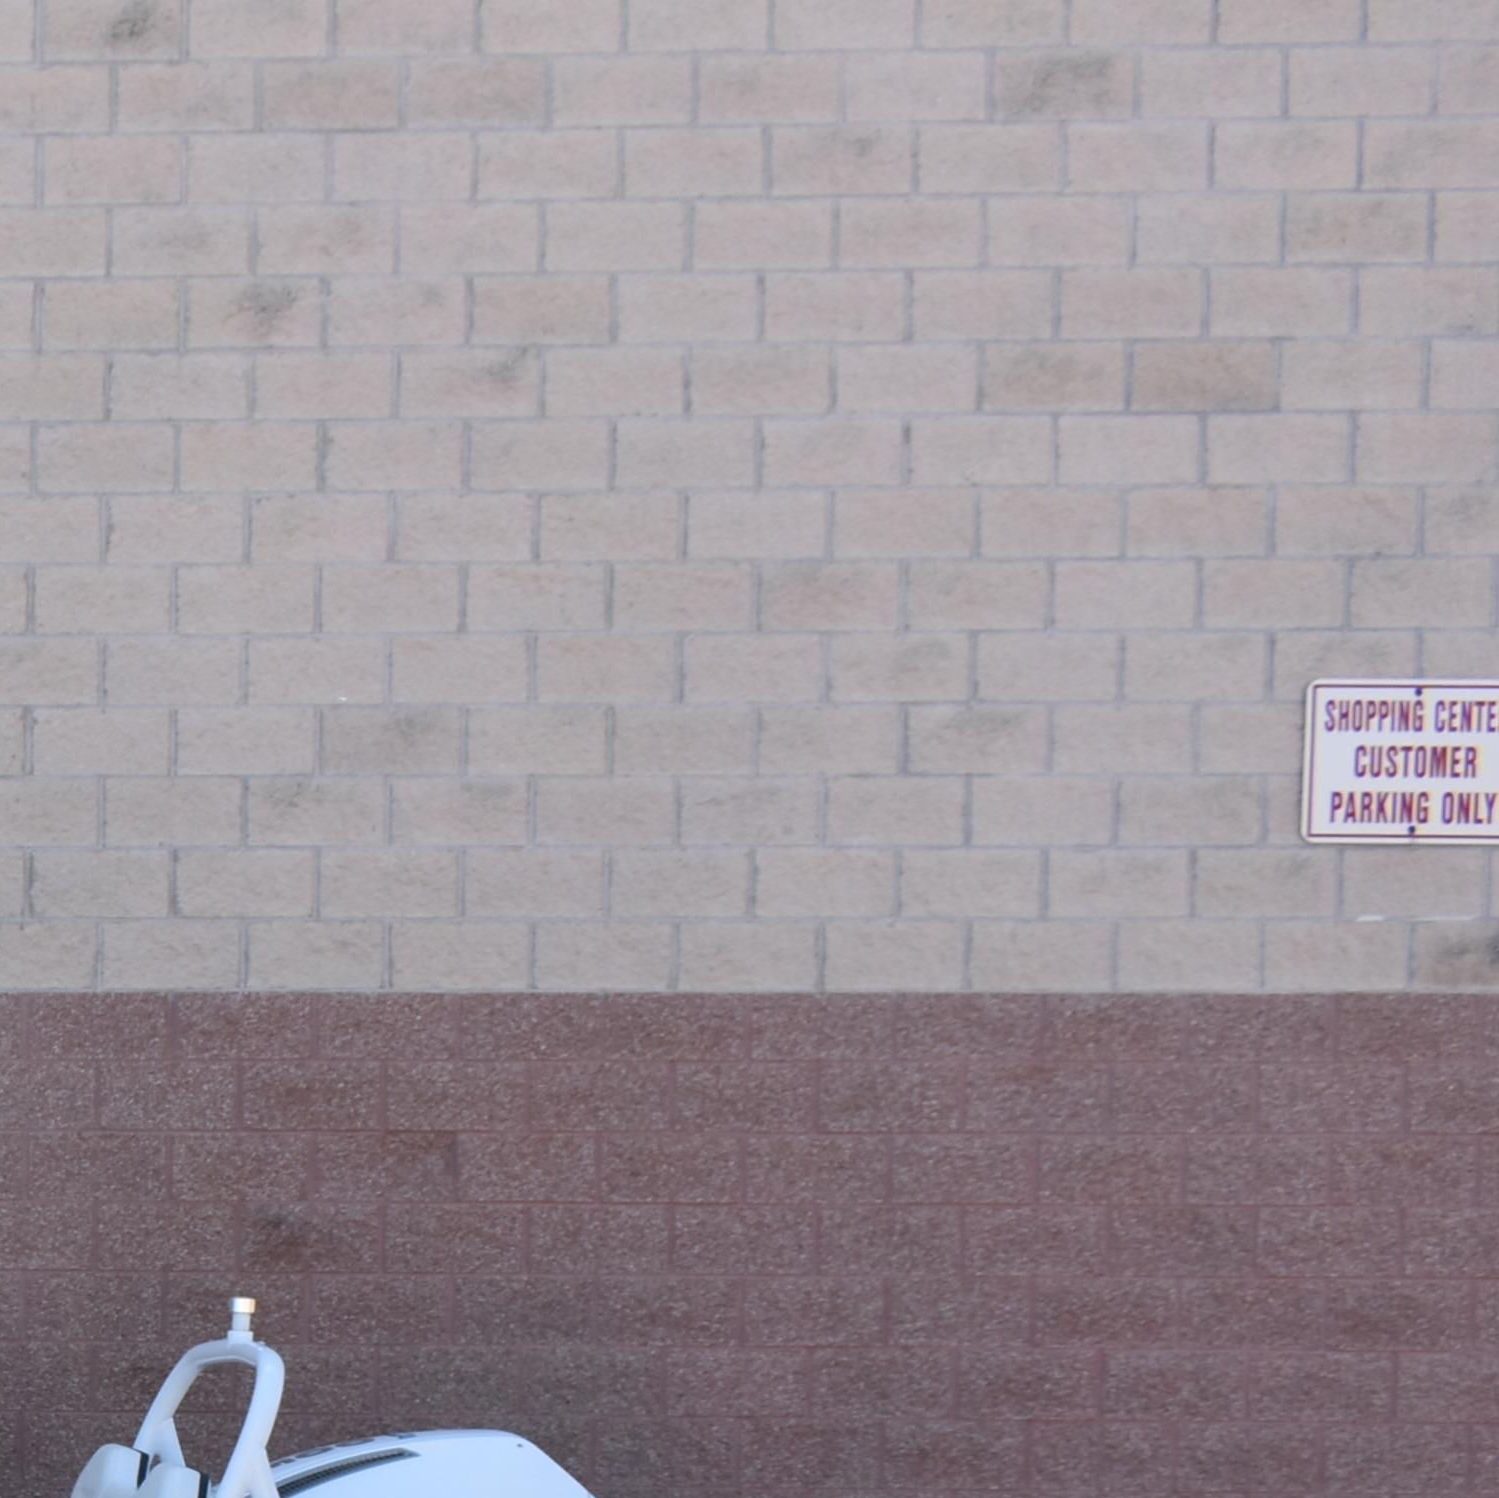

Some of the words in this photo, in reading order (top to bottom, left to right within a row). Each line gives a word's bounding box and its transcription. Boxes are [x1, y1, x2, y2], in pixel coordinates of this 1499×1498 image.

[1324, 699, 1425, 733] SHOPPING
[1434, 700, 1499, 733] CENTE
[1354, 745, 1478, 779] CUSTOMER
[1329, 791, 1430, 824] PARKING
[1441, 791, 1497, 824] ONLY
